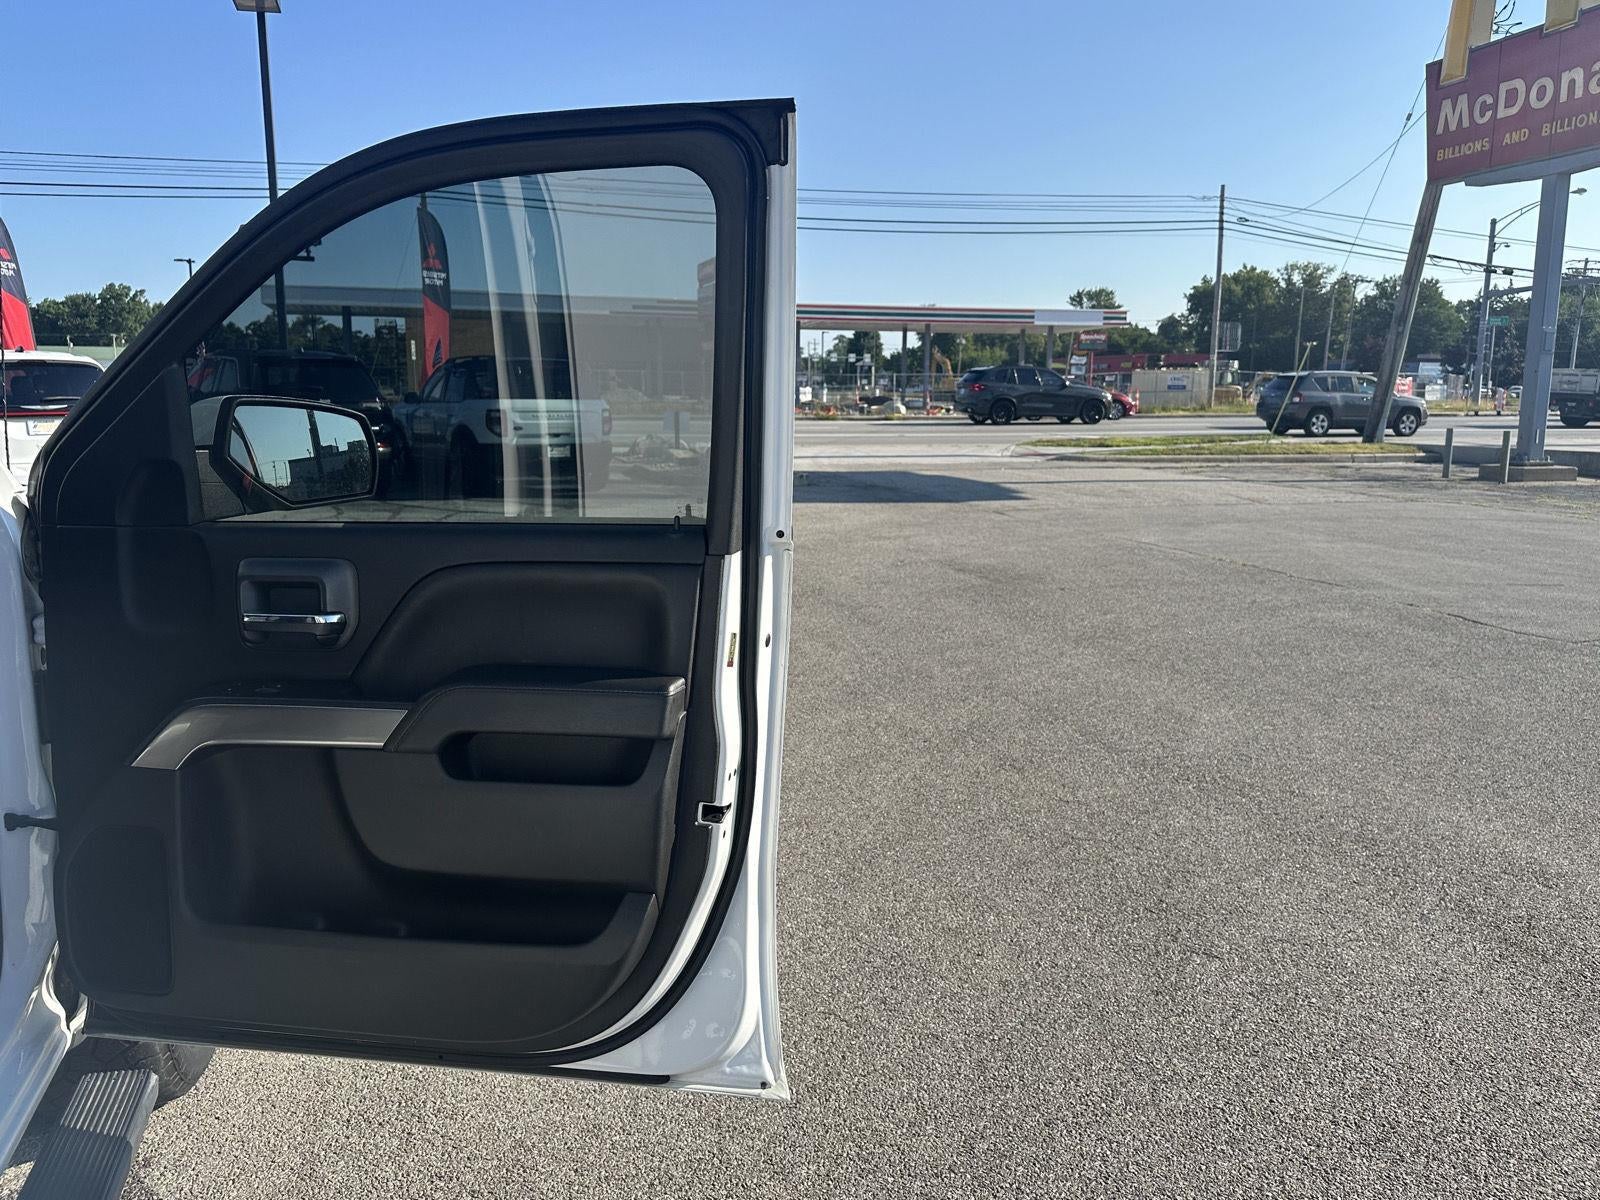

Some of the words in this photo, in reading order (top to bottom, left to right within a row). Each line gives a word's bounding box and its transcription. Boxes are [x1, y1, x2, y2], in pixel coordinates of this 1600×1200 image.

[1436, 138, 1490, 161] BILLIONS
[1502, 128, 1529, 146] AND
[1541, 110, 1600, 137] BILLION
